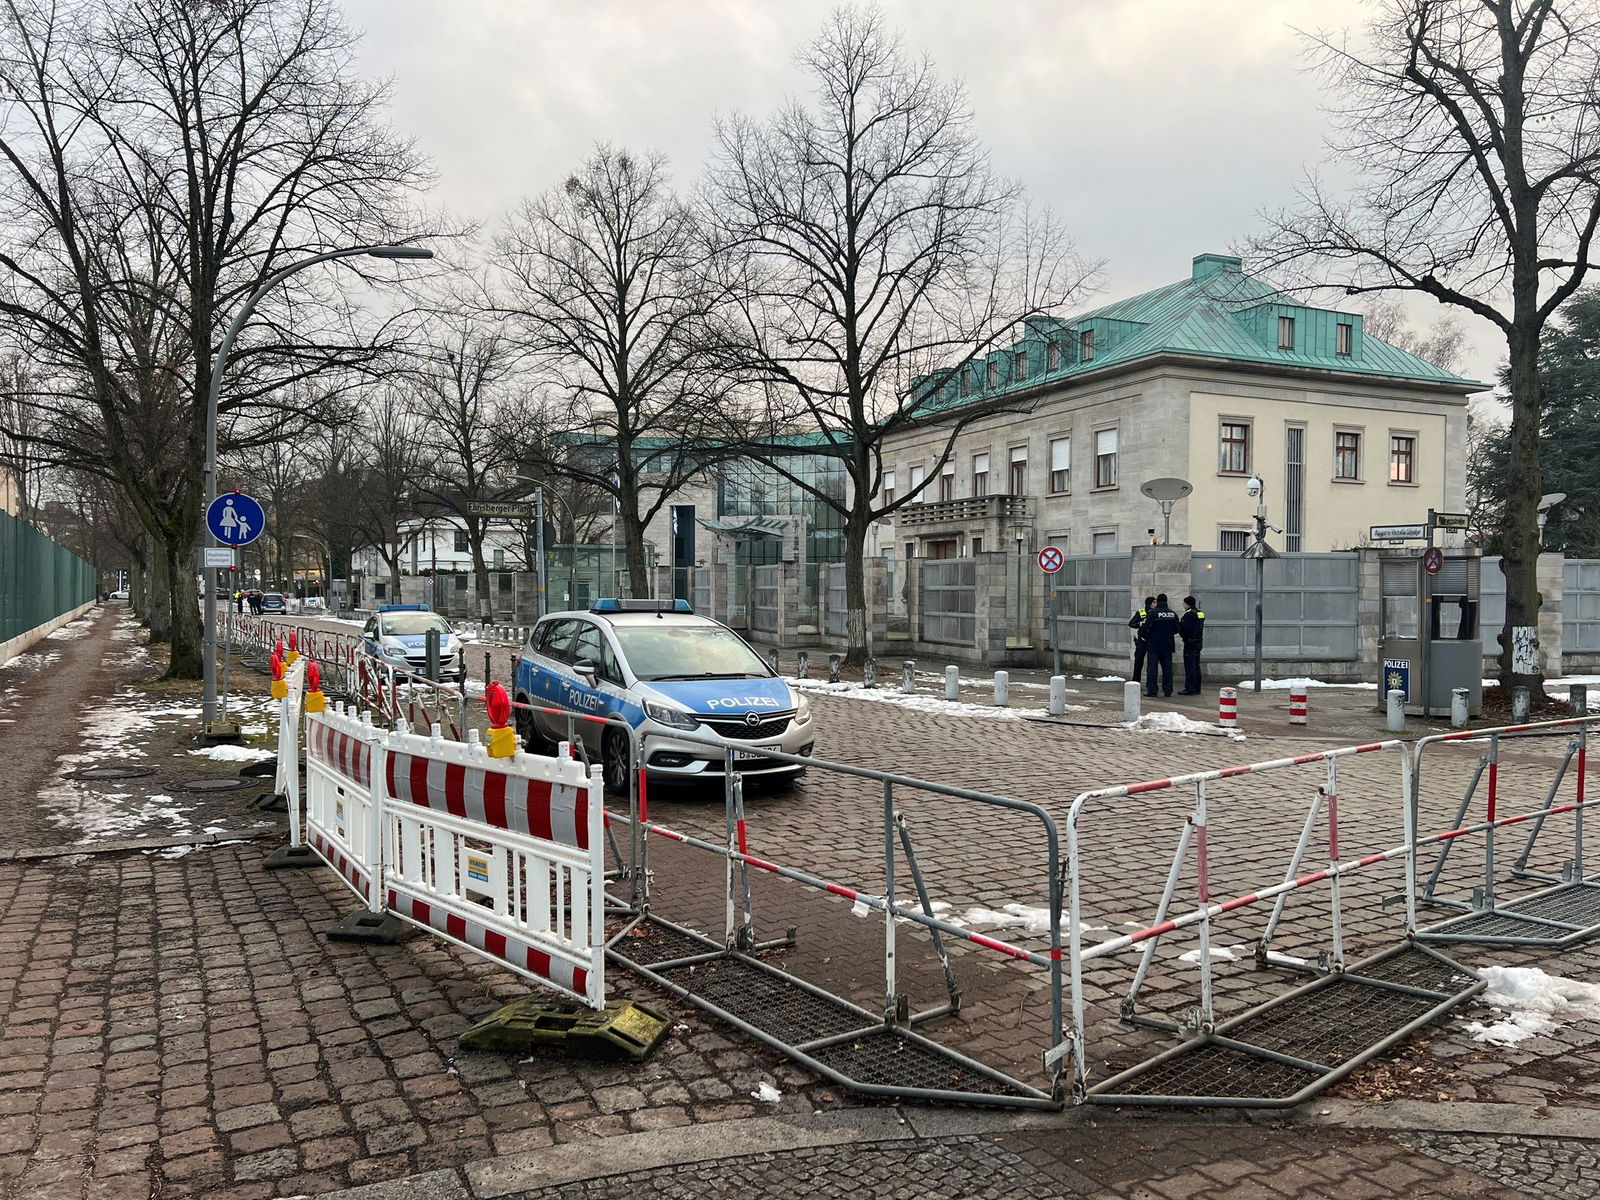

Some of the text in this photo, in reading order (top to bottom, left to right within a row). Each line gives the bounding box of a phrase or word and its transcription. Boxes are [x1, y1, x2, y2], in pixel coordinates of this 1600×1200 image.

[1384, 660, 1408, 669] POLIZEI
[569, 689, 598, 711] POLIZEI
[706, 697, 780, 710] POLIZEI
